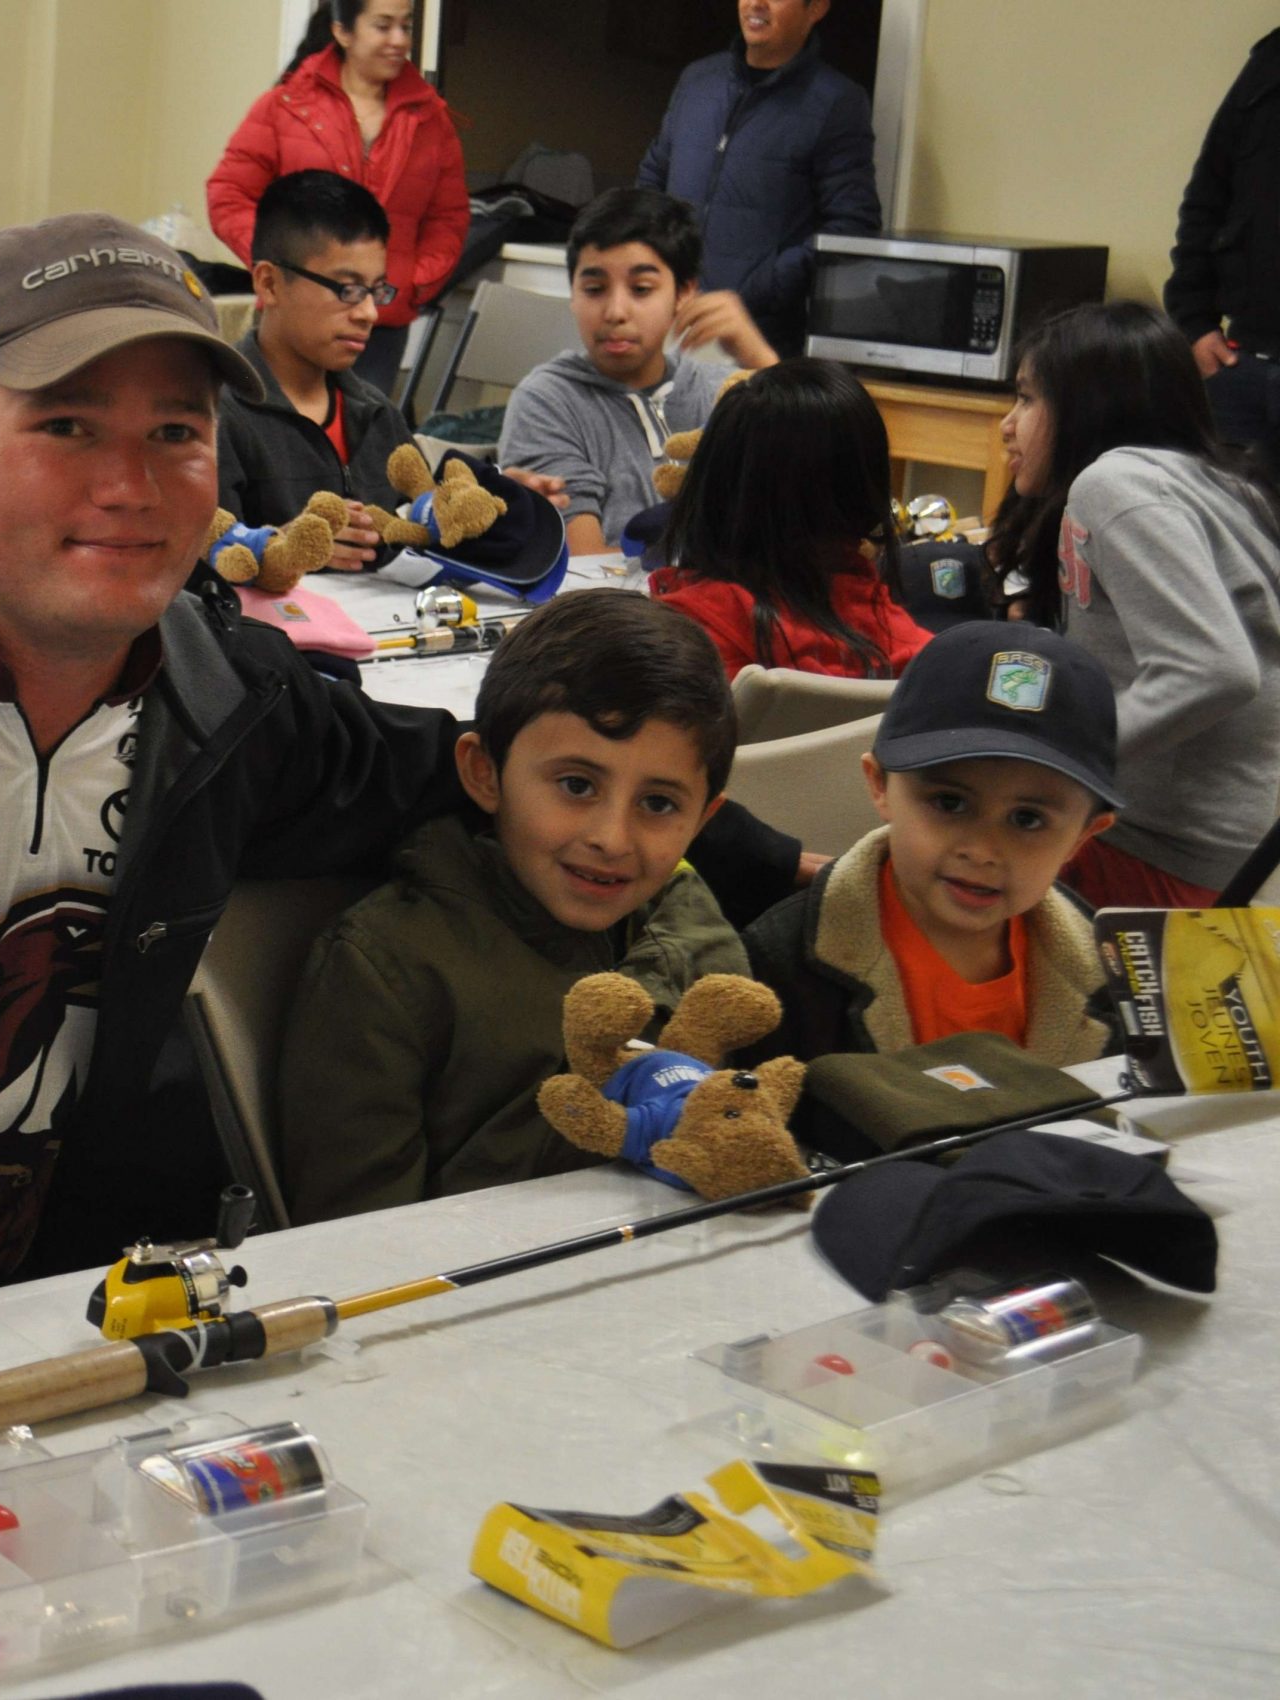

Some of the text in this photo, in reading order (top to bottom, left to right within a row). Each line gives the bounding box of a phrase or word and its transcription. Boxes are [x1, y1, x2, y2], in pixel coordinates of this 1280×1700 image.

[1125, 931, 1161, 993] CATCH
[1134, 995, 1165, 1036] FISH
[1186, 1001, 1231, 1083] JOVEN
[1203, 987, 1247, 1081] JEUNES
[1224, 988, 1269, 1080] YOUTH
